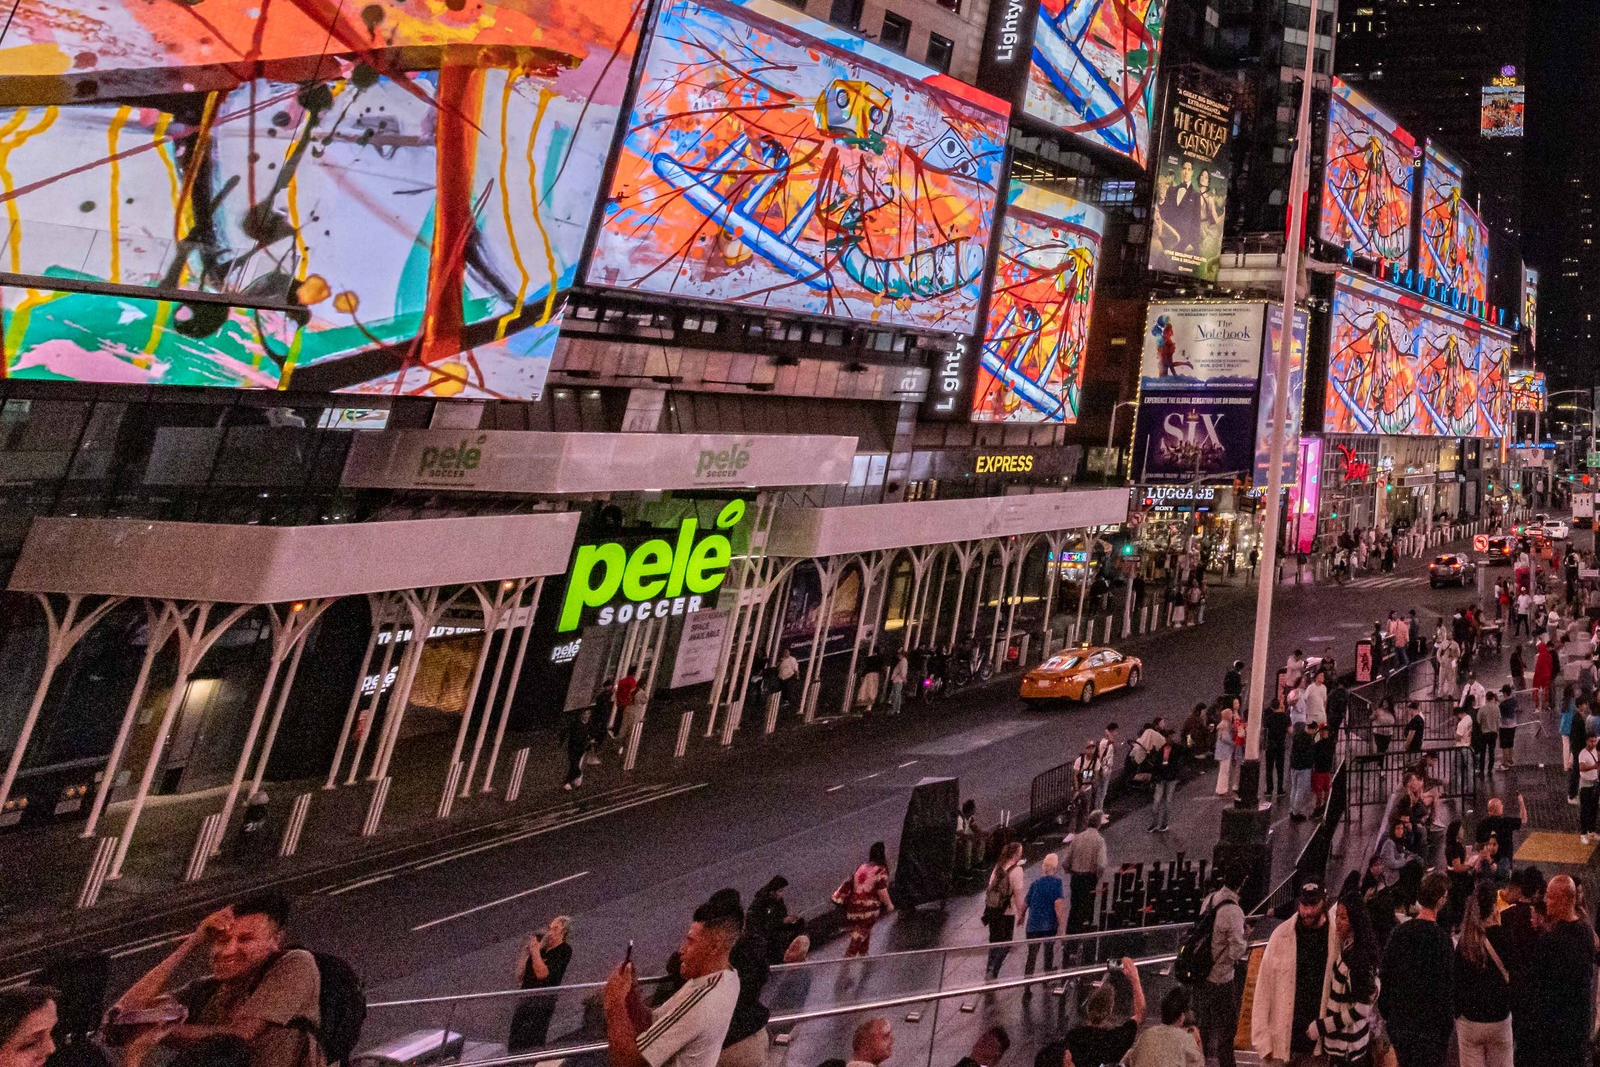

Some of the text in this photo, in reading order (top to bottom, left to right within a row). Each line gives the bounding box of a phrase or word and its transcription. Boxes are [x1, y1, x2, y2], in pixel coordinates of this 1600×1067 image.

[1174, 109, 1193, 131] THE
[1194, 119, 1228, 144] GREAT
[1177, 131, 1222, 158] GATSBY
[1195, 324, 1251, 339] Notebook
[418, 434, 487, 477] pelé
[695, 438, 754, 478] pelé
[975, 455, 1034, 474] EXPRESS
[428, 469, 465, 478] SOCCER
[706, 470, 738, 478] SOCCER
[1146, 487, 1214, 500] LUGGAGE
[558, 498, 746, 633] pelé
[598, 596, 702, 626] SOCCER
[551, 638, 582, 661] pelé
[361, 666, 399, 692] peé
